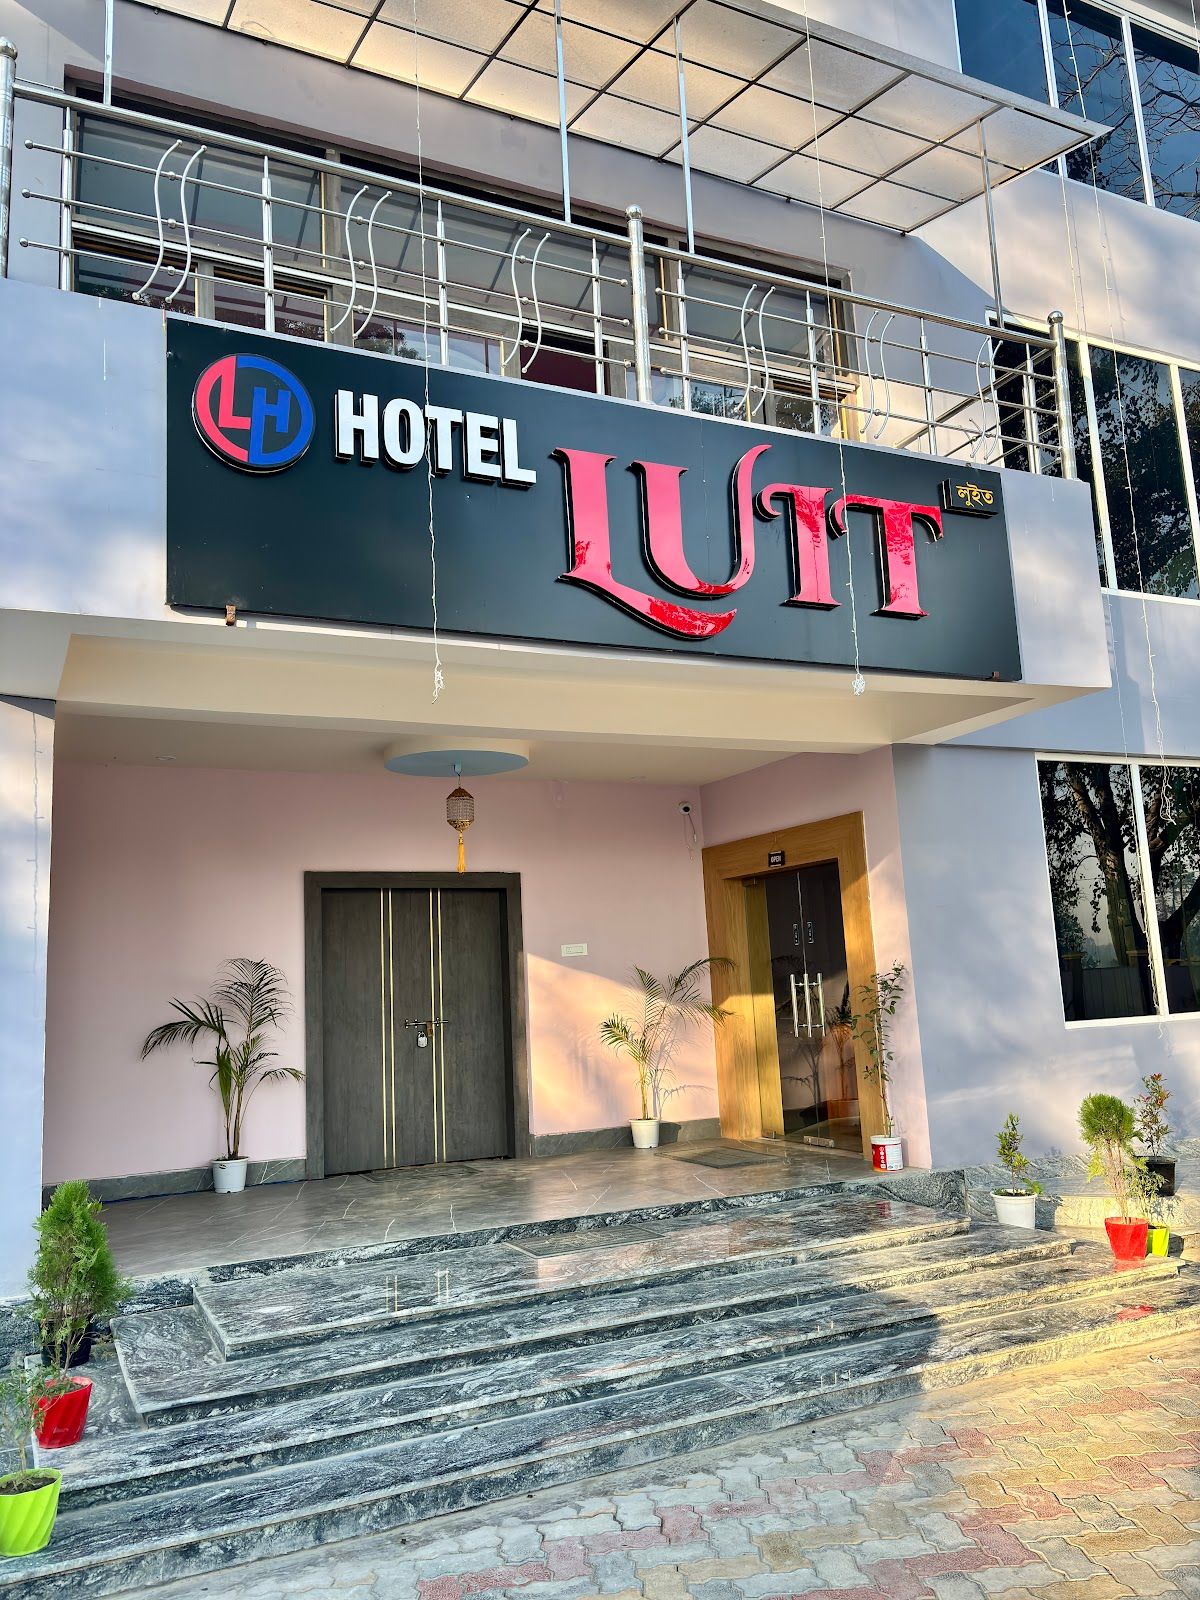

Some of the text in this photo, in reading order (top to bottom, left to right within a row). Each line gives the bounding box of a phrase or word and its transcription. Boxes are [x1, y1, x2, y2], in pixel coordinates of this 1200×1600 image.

[955, 481, 994, 508] লুইত
[335, 389, 943, 639] HOTEL LUIT
[770, 855, 782, 863] OPEN
